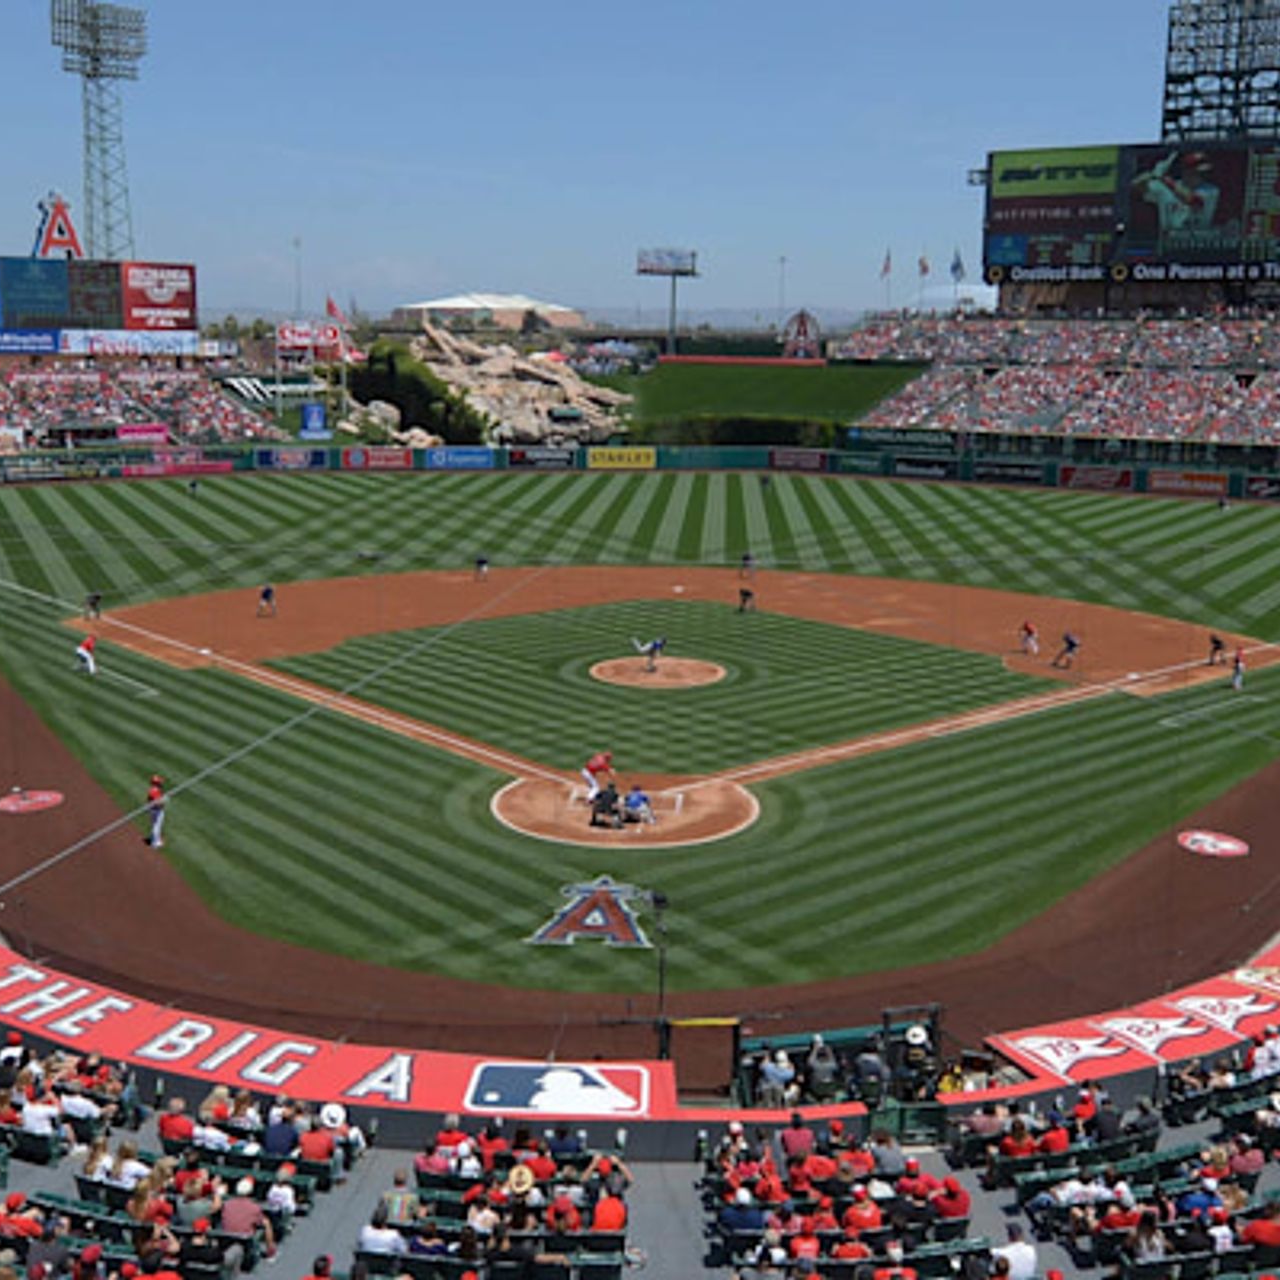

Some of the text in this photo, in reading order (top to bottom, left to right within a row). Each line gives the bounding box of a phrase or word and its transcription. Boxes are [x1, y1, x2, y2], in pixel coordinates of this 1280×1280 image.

[1010, 263, 1104, 280] OneWest Bank
[1132, 263, 1166, 281] One
[1170, 262, 1223, 280] Person
[1225, 263, 1245, 280] at
[1247, 264, 1261, 280] a
[133, 1019, 318, 1087] BIG
[343, 1053, 418, 1102] A
